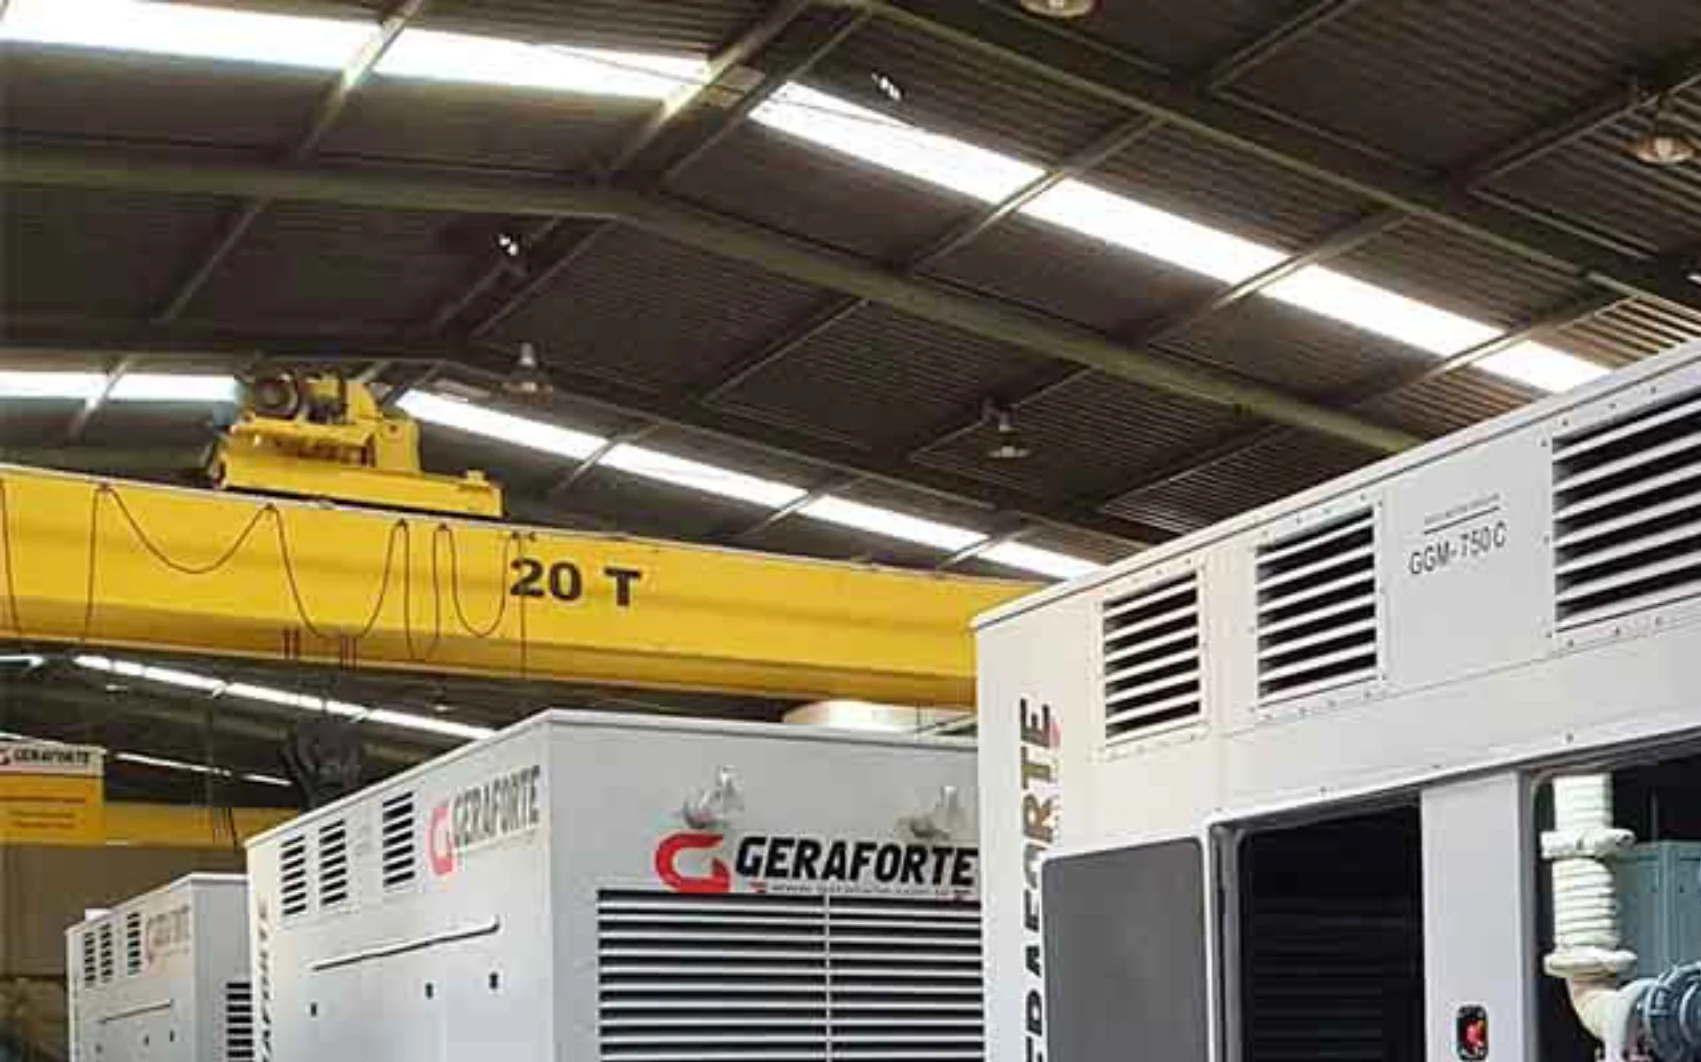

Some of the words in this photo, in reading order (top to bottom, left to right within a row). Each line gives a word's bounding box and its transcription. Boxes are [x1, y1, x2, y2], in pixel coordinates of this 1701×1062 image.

[510, 558, 582, 600] 20
[604, 566, 641, 607] T
[736, 836, 979, 886] GERAFORTE
